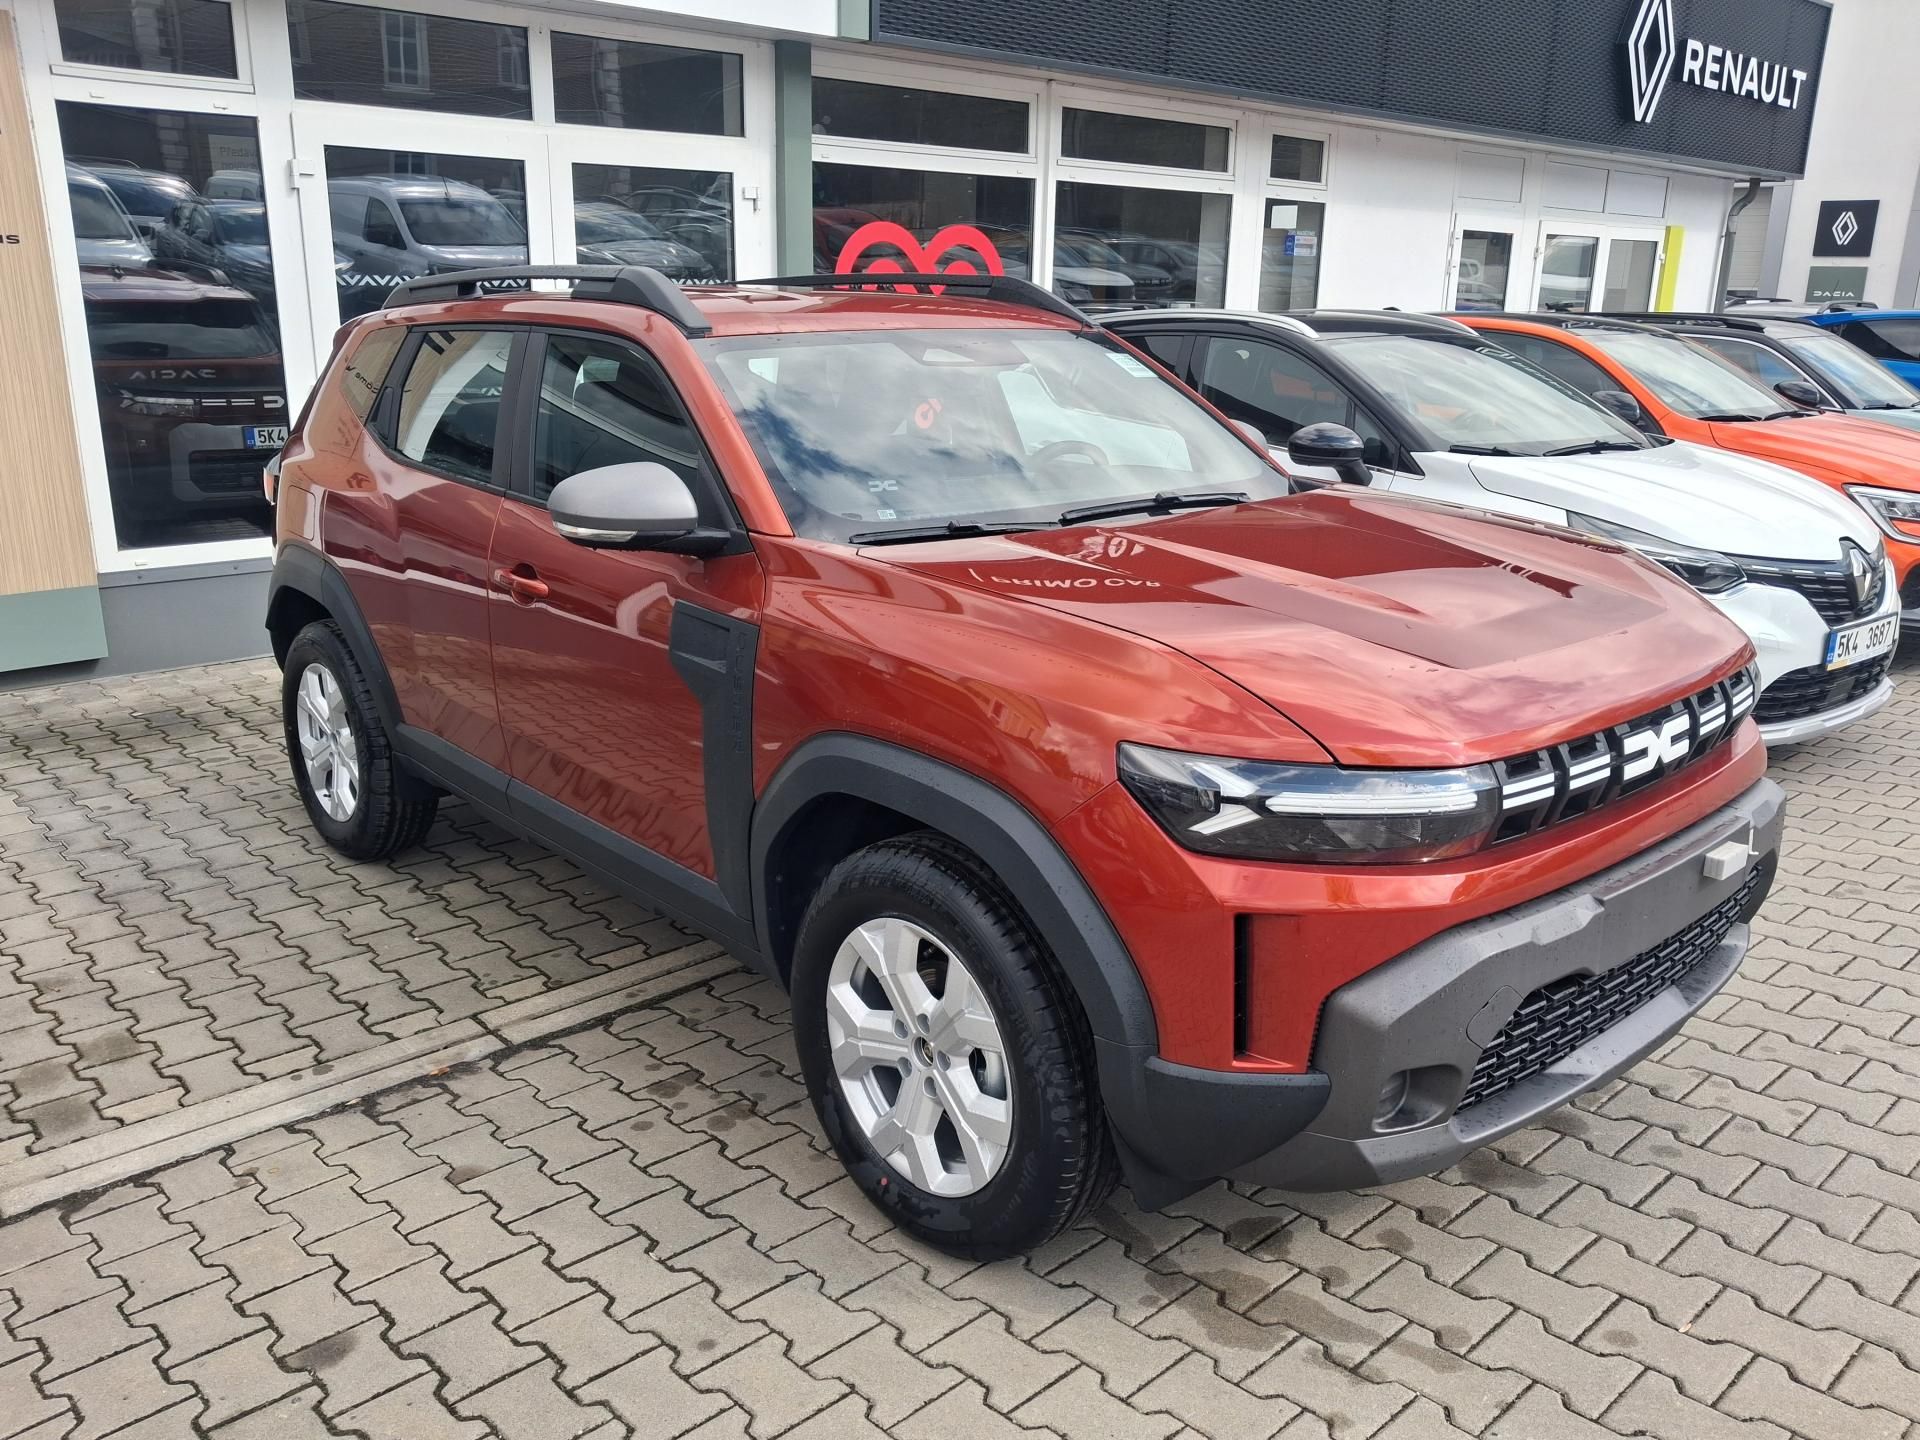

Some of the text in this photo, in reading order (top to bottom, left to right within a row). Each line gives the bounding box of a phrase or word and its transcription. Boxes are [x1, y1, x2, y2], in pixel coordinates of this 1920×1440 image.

[1683, 39, 1808, 110] RENAULT
[258, 429, 285, 444] 5K4
[1837, 620, 1892, 658] 5K4 3687
